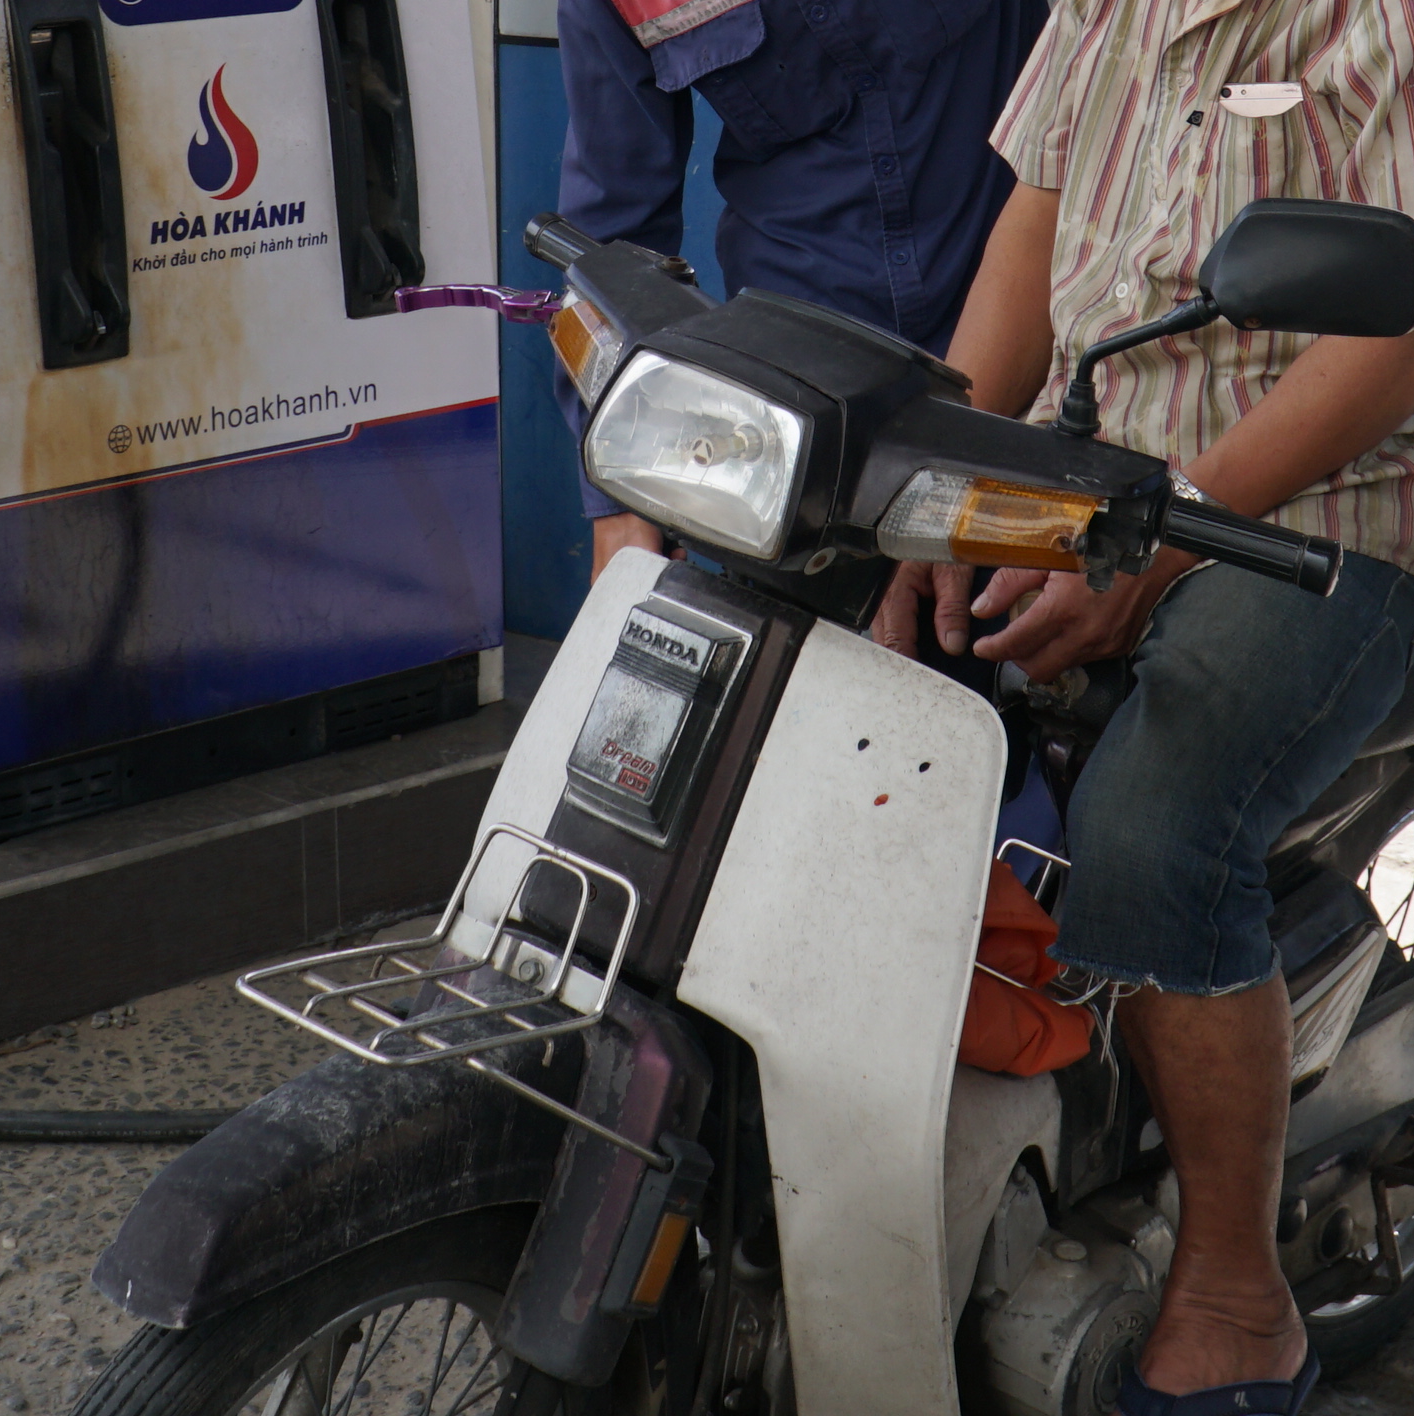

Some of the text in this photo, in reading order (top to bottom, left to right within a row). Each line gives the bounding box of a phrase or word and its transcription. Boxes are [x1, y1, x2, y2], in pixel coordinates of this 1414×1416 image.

[149, 200, 306, 246] HÒA KHÁNH
[200, 245, 227, 263] cho
[229, 241, 257, 262] mọi
[259, 235, 294, 255] hành
[296, 230, 329, 251] trình
[136, 382, 379, 446] www.hoakhanh.vn
[623, 620, 700, 667] HONDA
[602, 741, 657, 775] Dream
